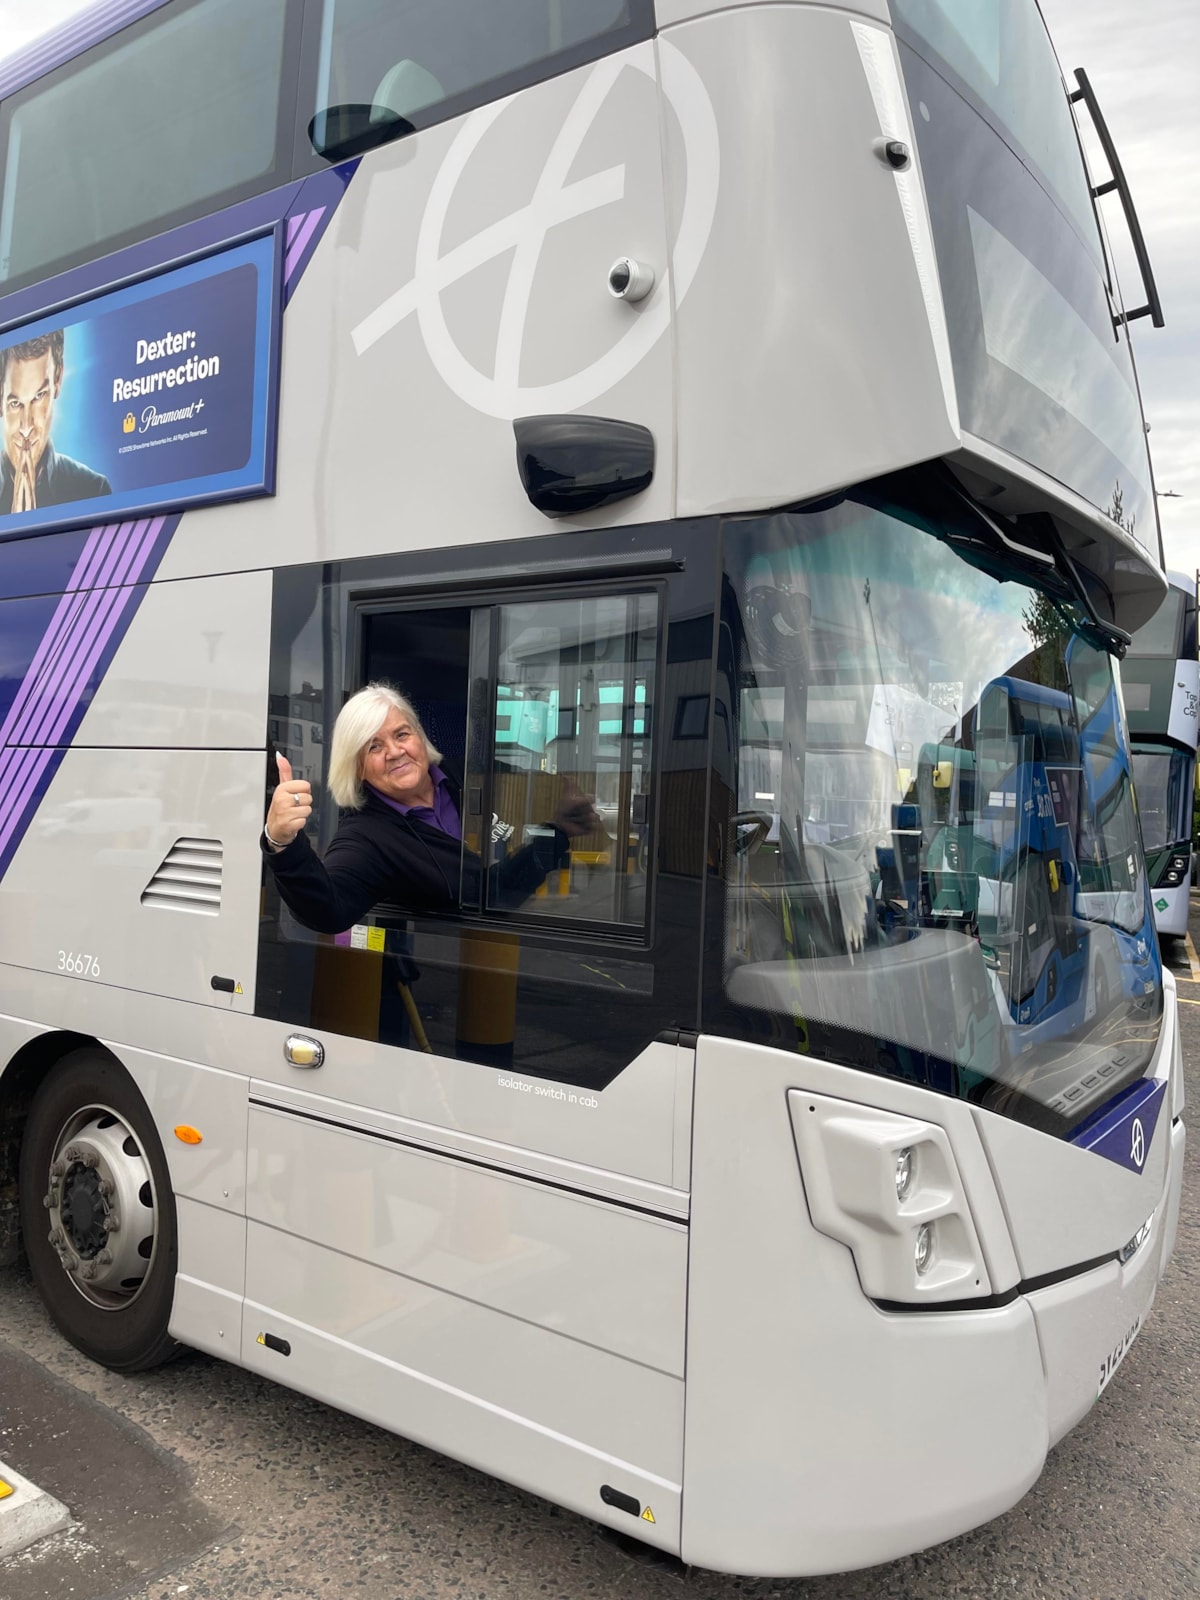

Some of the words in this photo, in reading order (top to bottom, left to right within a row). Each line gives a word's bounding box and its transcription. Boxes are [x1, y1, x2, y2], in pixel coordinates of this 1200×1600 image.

[136, 330, 196, 365] Dexter:
[112, 355, 220, 403] Resurrection
[138, 398, 205, 434] Paramount+
[57, 949, 100, 977] 36676
[497, 1075, 533, 1093] isolator
[535, 1086, 566, 1102] switch
[568, 1090, 577, 1104] in
[579, 1096, 598, 1109] cab
